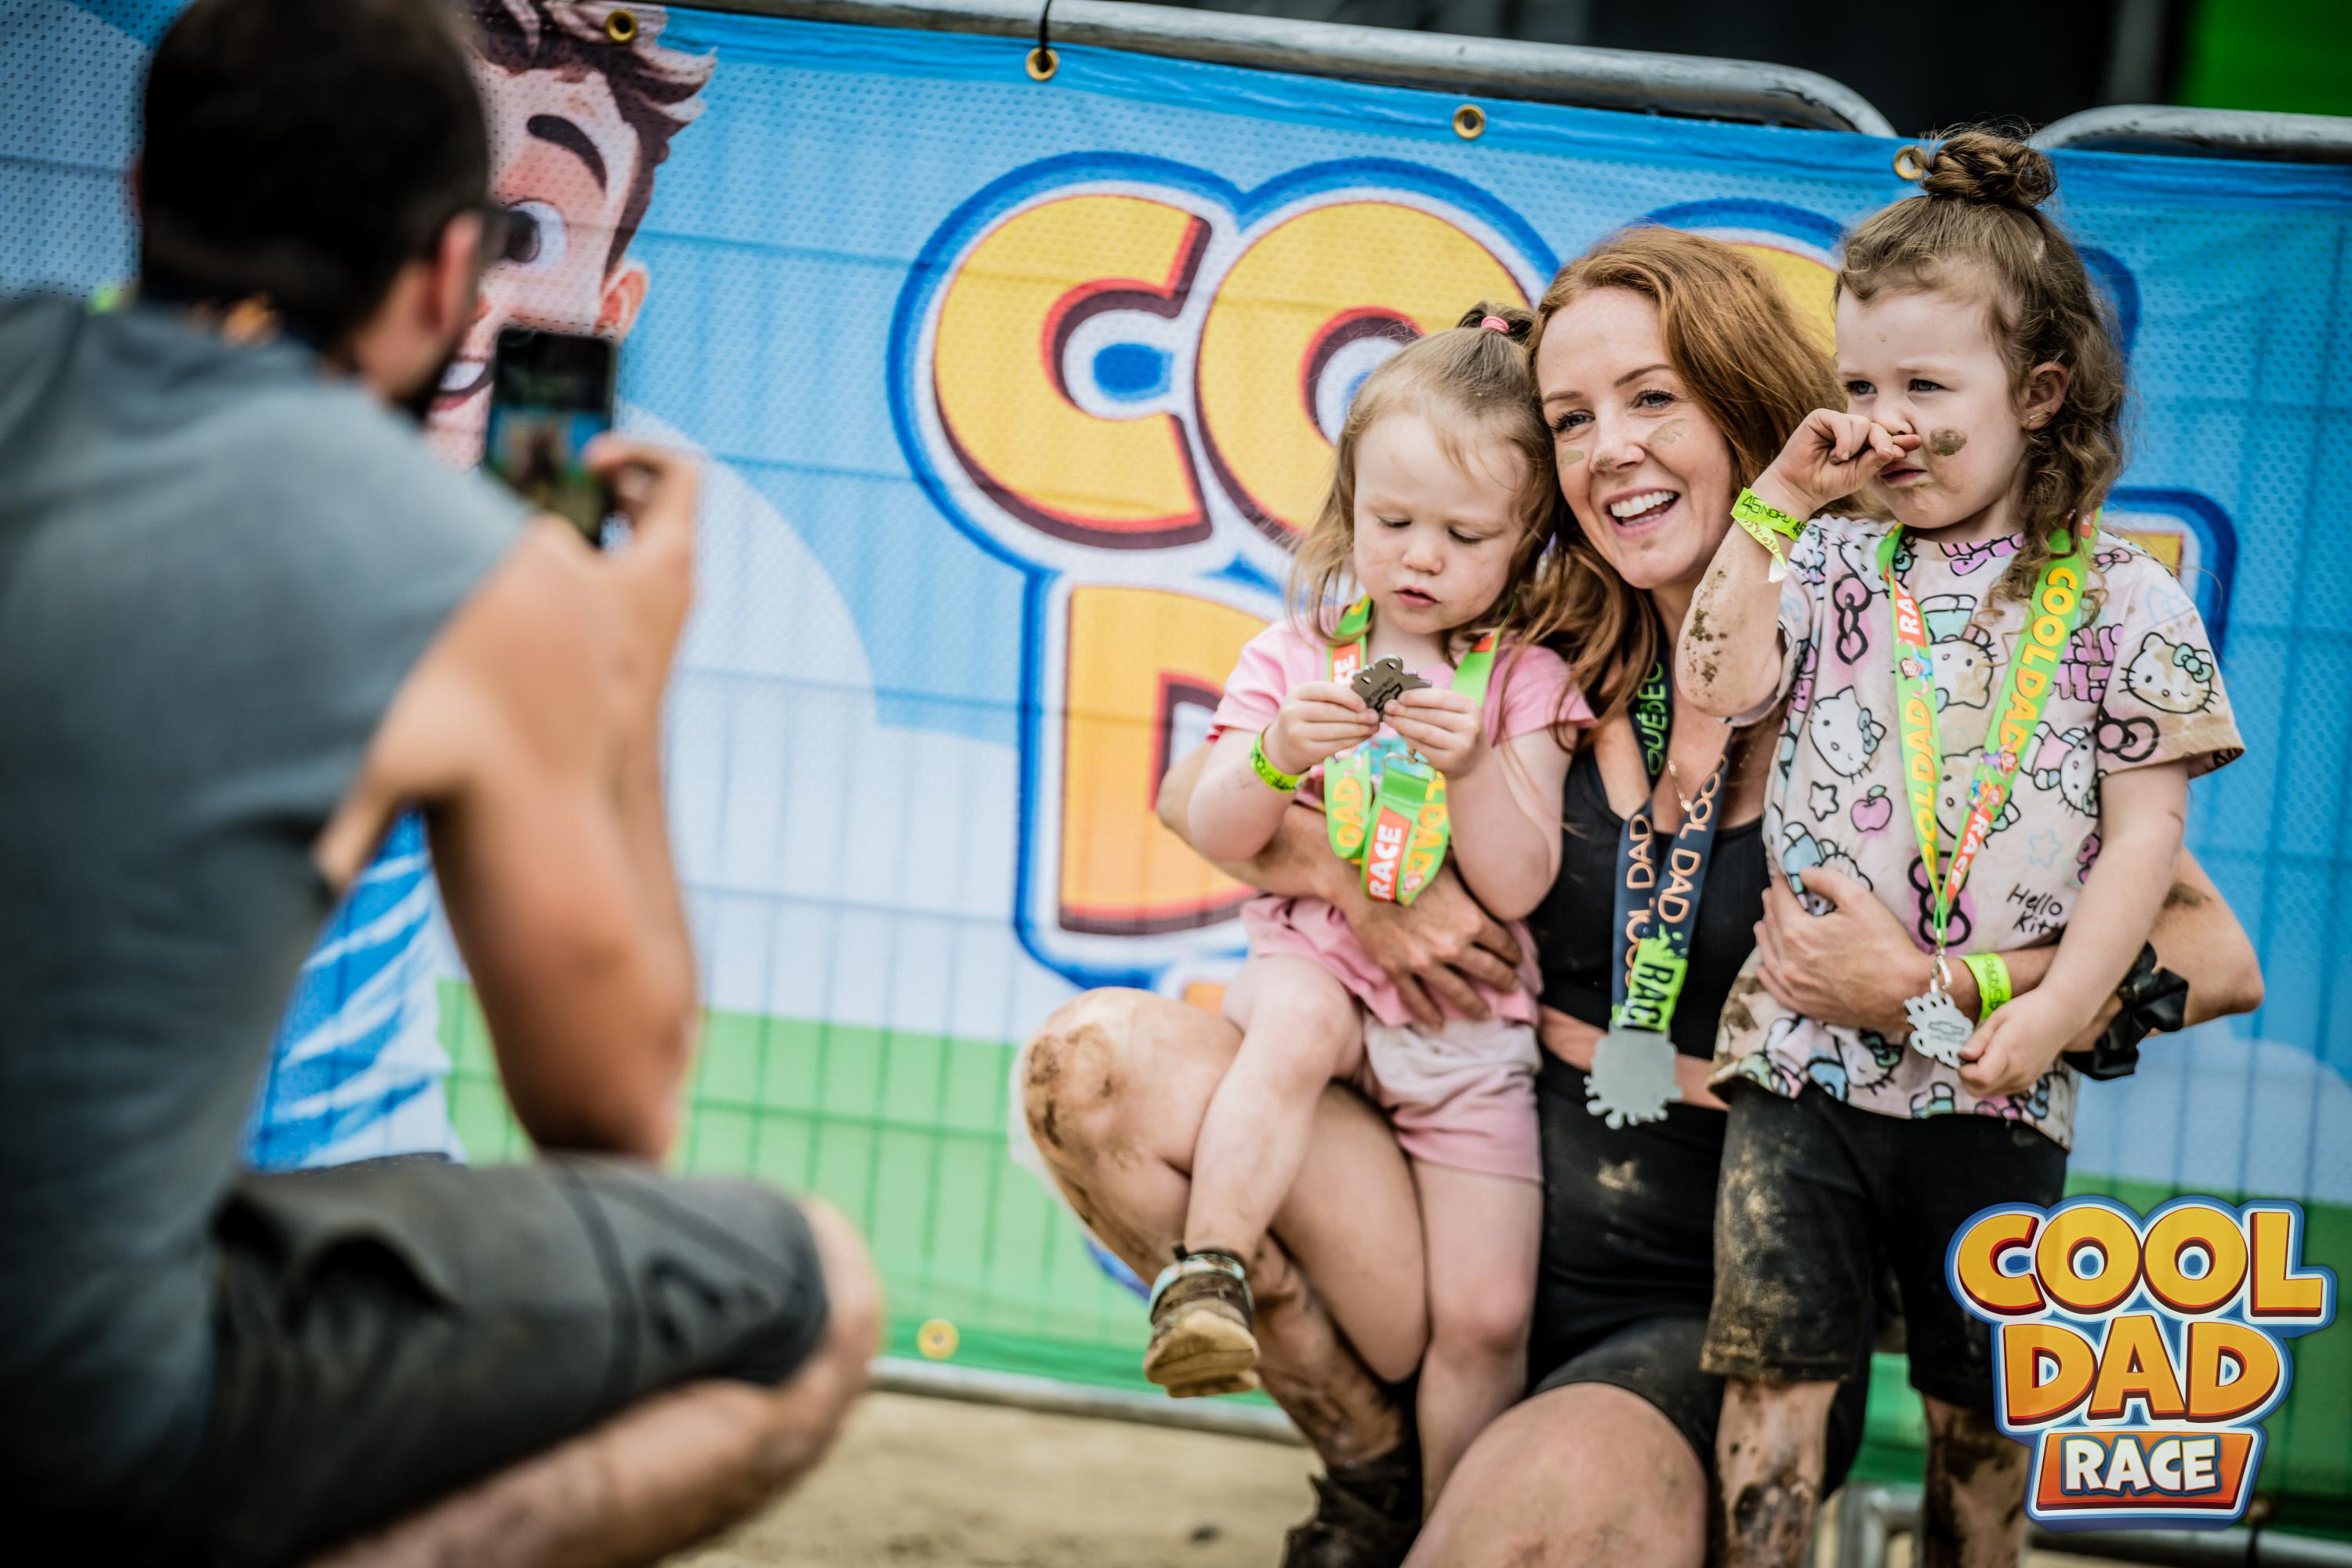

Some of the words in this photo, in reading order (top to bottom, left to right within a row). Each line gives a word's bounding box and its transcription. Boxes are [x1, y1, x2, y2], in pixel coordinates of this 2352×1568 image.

[1895, 579, 1920, 635] RAC
[1332, 778, 1364, 848] DAD
[1369, 824, 1402, 900] RACE
[1626, 814, 1655, 889] DAD
[1658, 848, 1701, 924] DAD
[1951, 813, 1989, 888] RACE
[2006, 883, 2063, 916] Hello
[1628, 963, 1675, 1024] RAC
